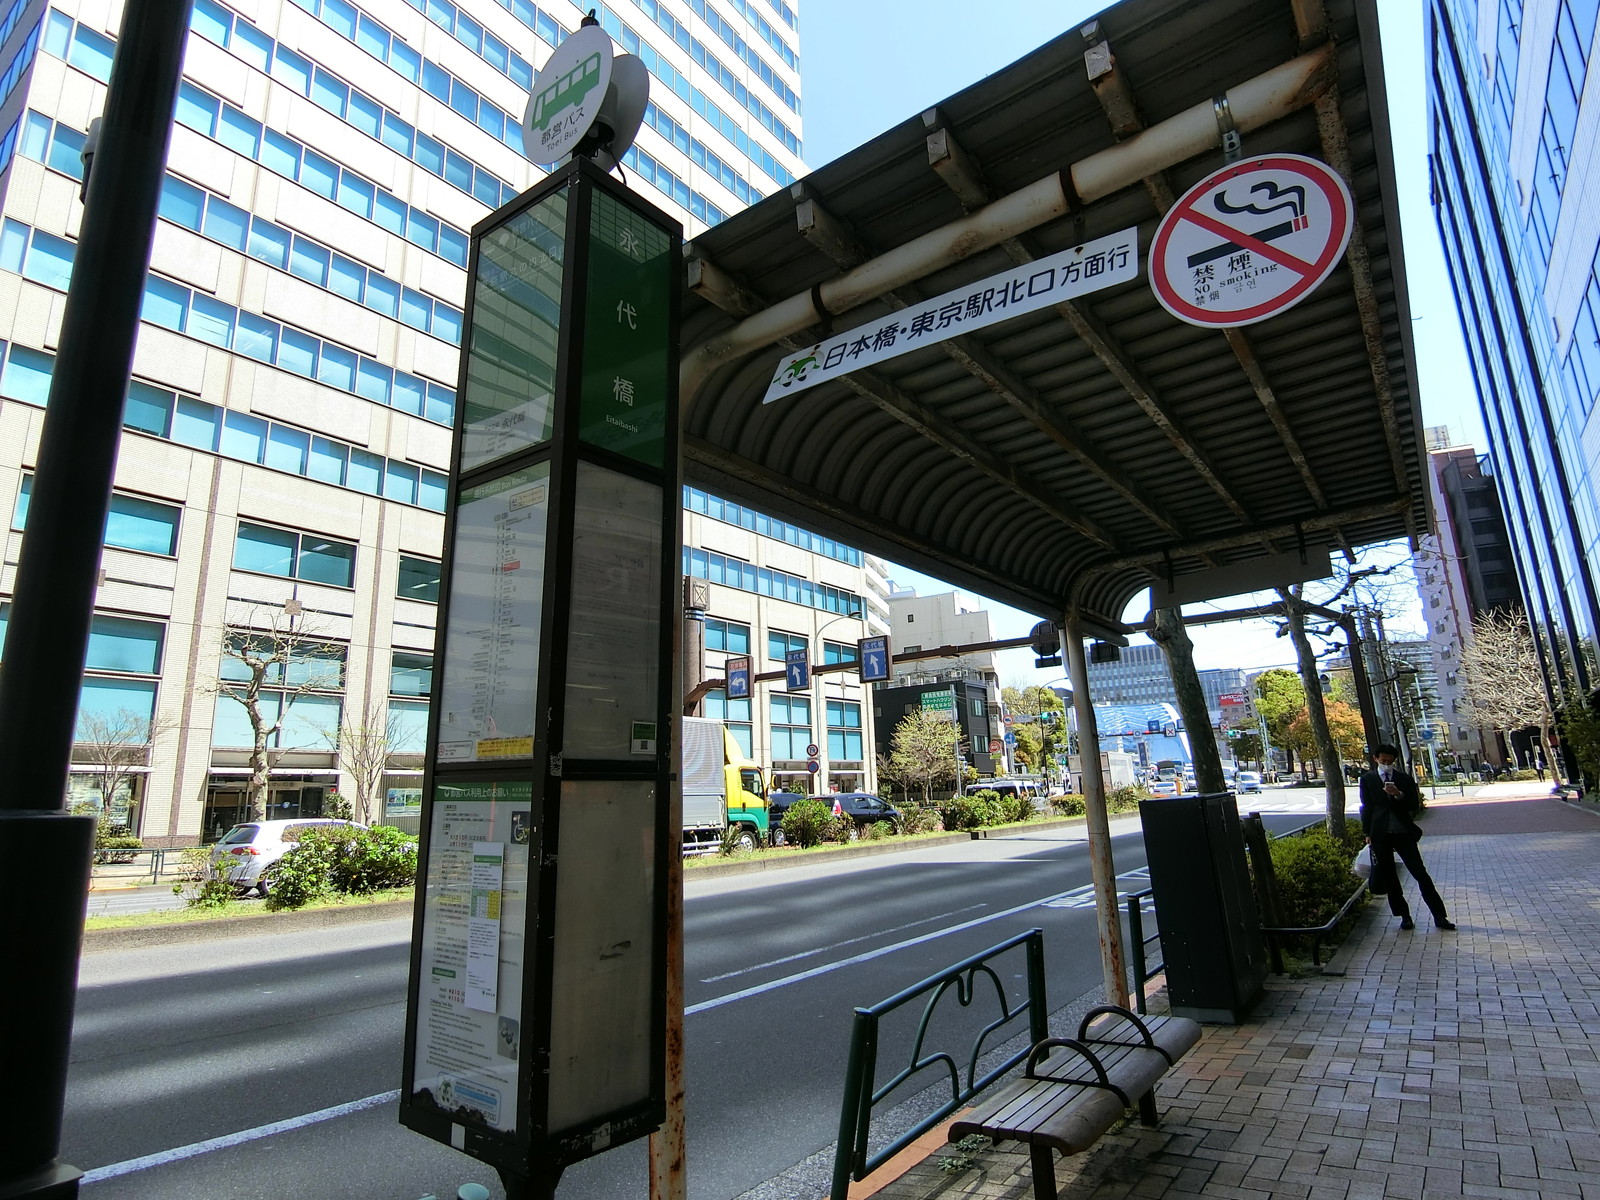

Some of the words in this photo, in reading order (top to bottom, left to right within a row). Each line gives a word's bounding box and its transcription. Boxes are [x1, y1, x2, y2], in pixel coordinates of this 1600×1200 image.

[541, 106, 585, 146] 都営バス
[546, 136, 563, 152] Toei
[564, 127, 578, 141] Bus
[1193, 250, 1253, 287] 禁煙
[1194, 283, 1211, 296] NO
[1219, 263, 1278, 288] smoking
[1233, 277, 1257, 294] 금연
[613, 227, 640, 408] 永代橋
[822, 242, 1131, 371] 日本橋・東京駅北口方面行
[605, 414, 639, 434] Eitaibashi
